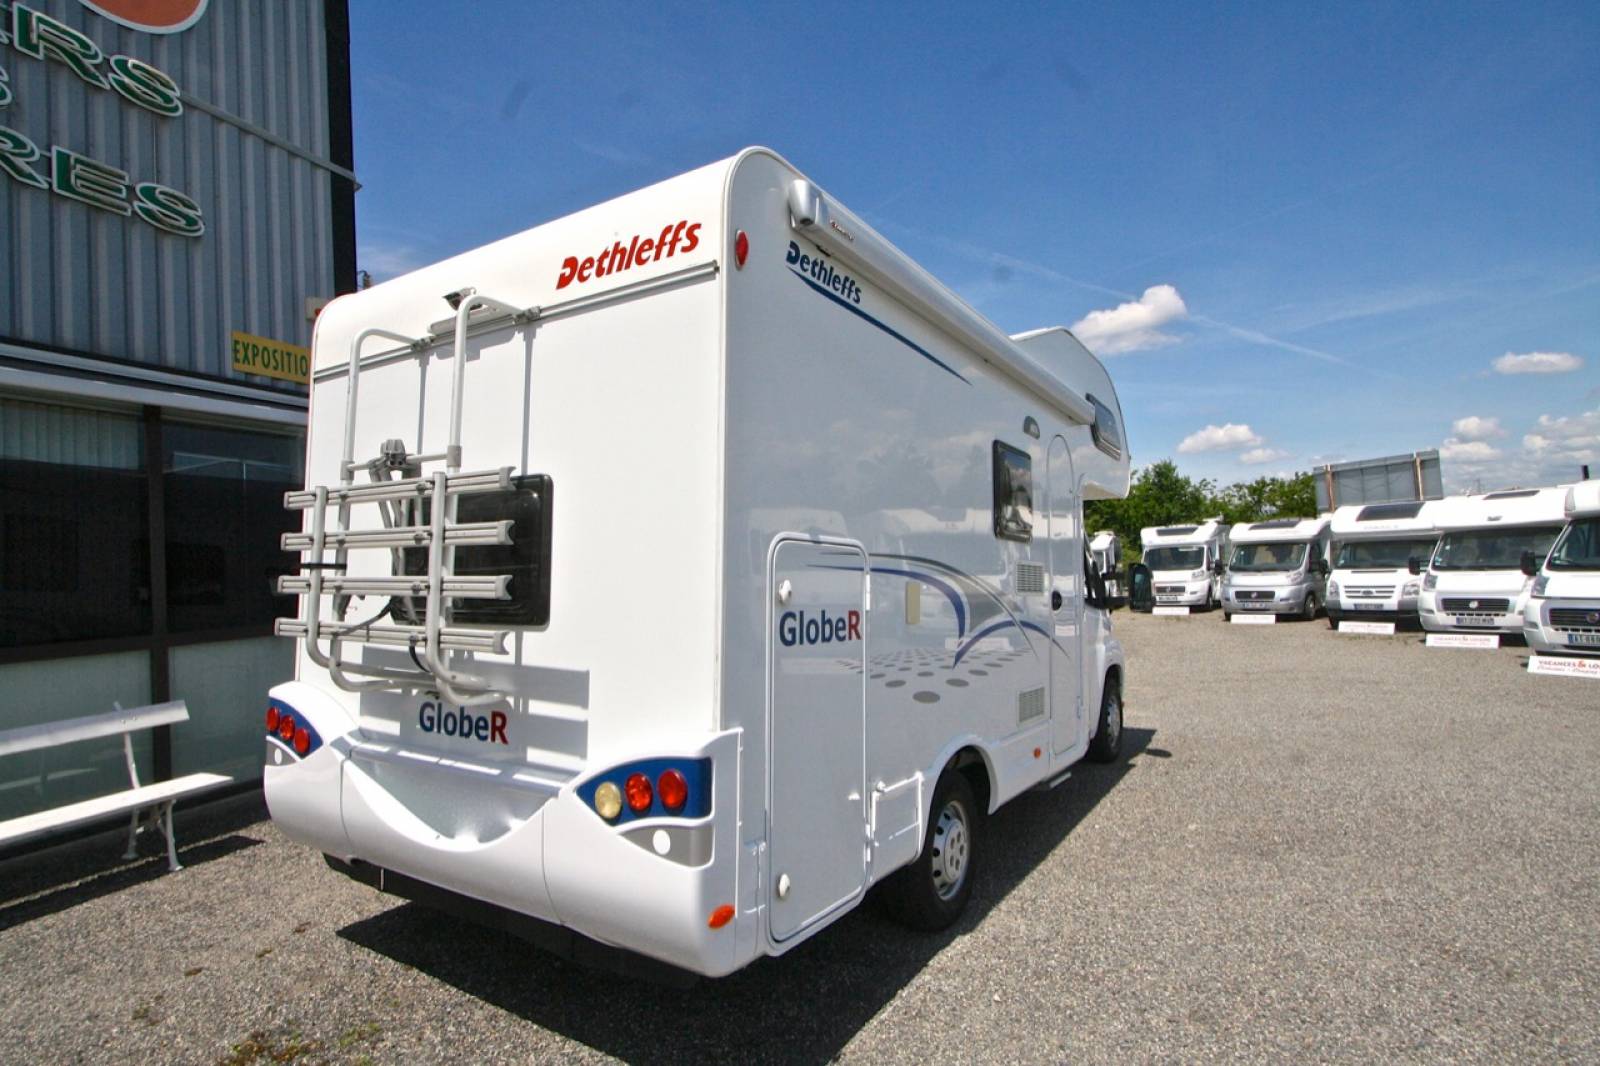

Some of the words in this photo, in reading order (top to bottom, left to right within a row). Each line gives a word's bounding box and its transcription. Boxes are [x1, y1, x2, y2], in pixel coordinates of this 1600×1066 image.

[0, 1, 184, 117] RS
[556, 220, 702, 290] Dethleffs
[785, 240, 862, 305] Dethleffs
[232, 339, 309, 377] EXPOSITIO
[779, 610, 862, 646] GlobeR
[418, 700, 510, 745] GlobeR
